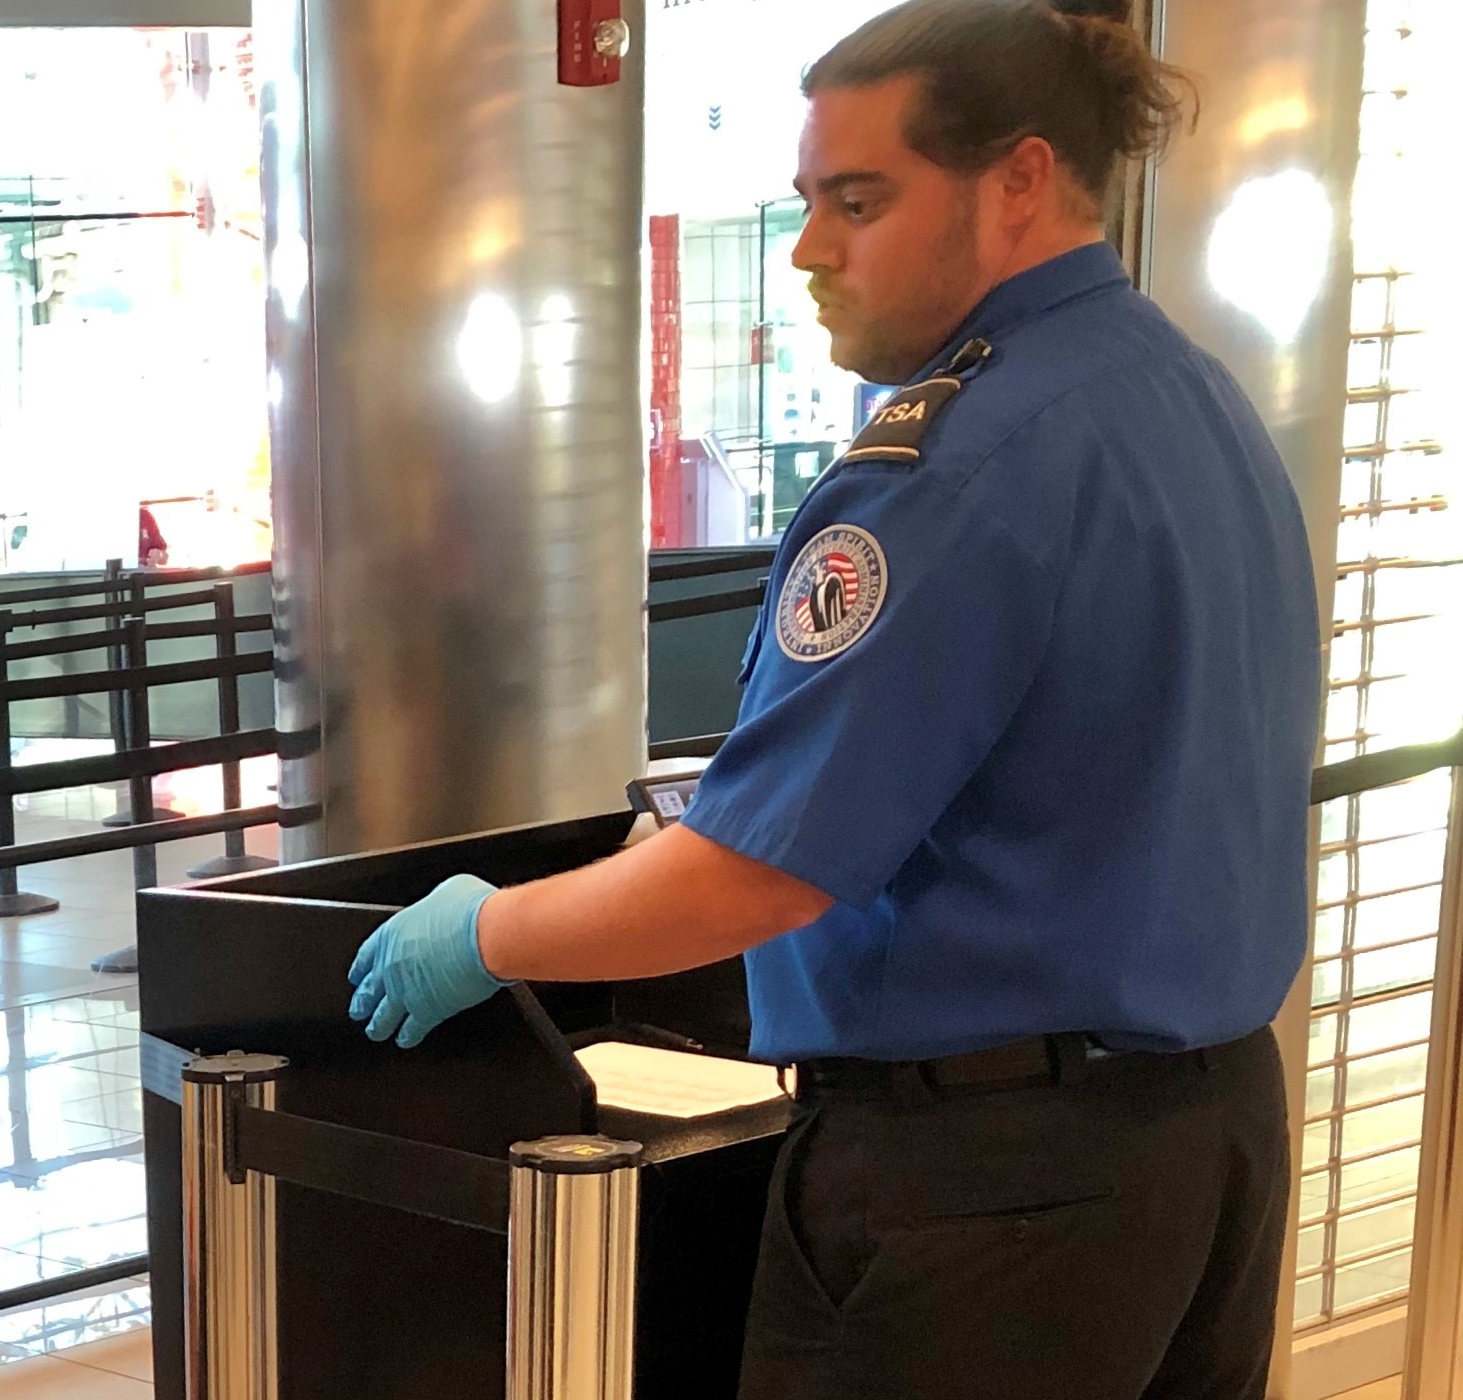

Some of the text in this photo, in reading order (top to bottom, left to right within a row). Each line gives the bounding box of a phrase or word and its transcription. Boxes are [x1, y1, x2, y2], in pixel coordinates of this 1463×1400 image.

[873, 399, 927, 425] TSA
[838, 532, 876, 560] SPIRIT
[816, 574, 881, 653] INNOVATION
